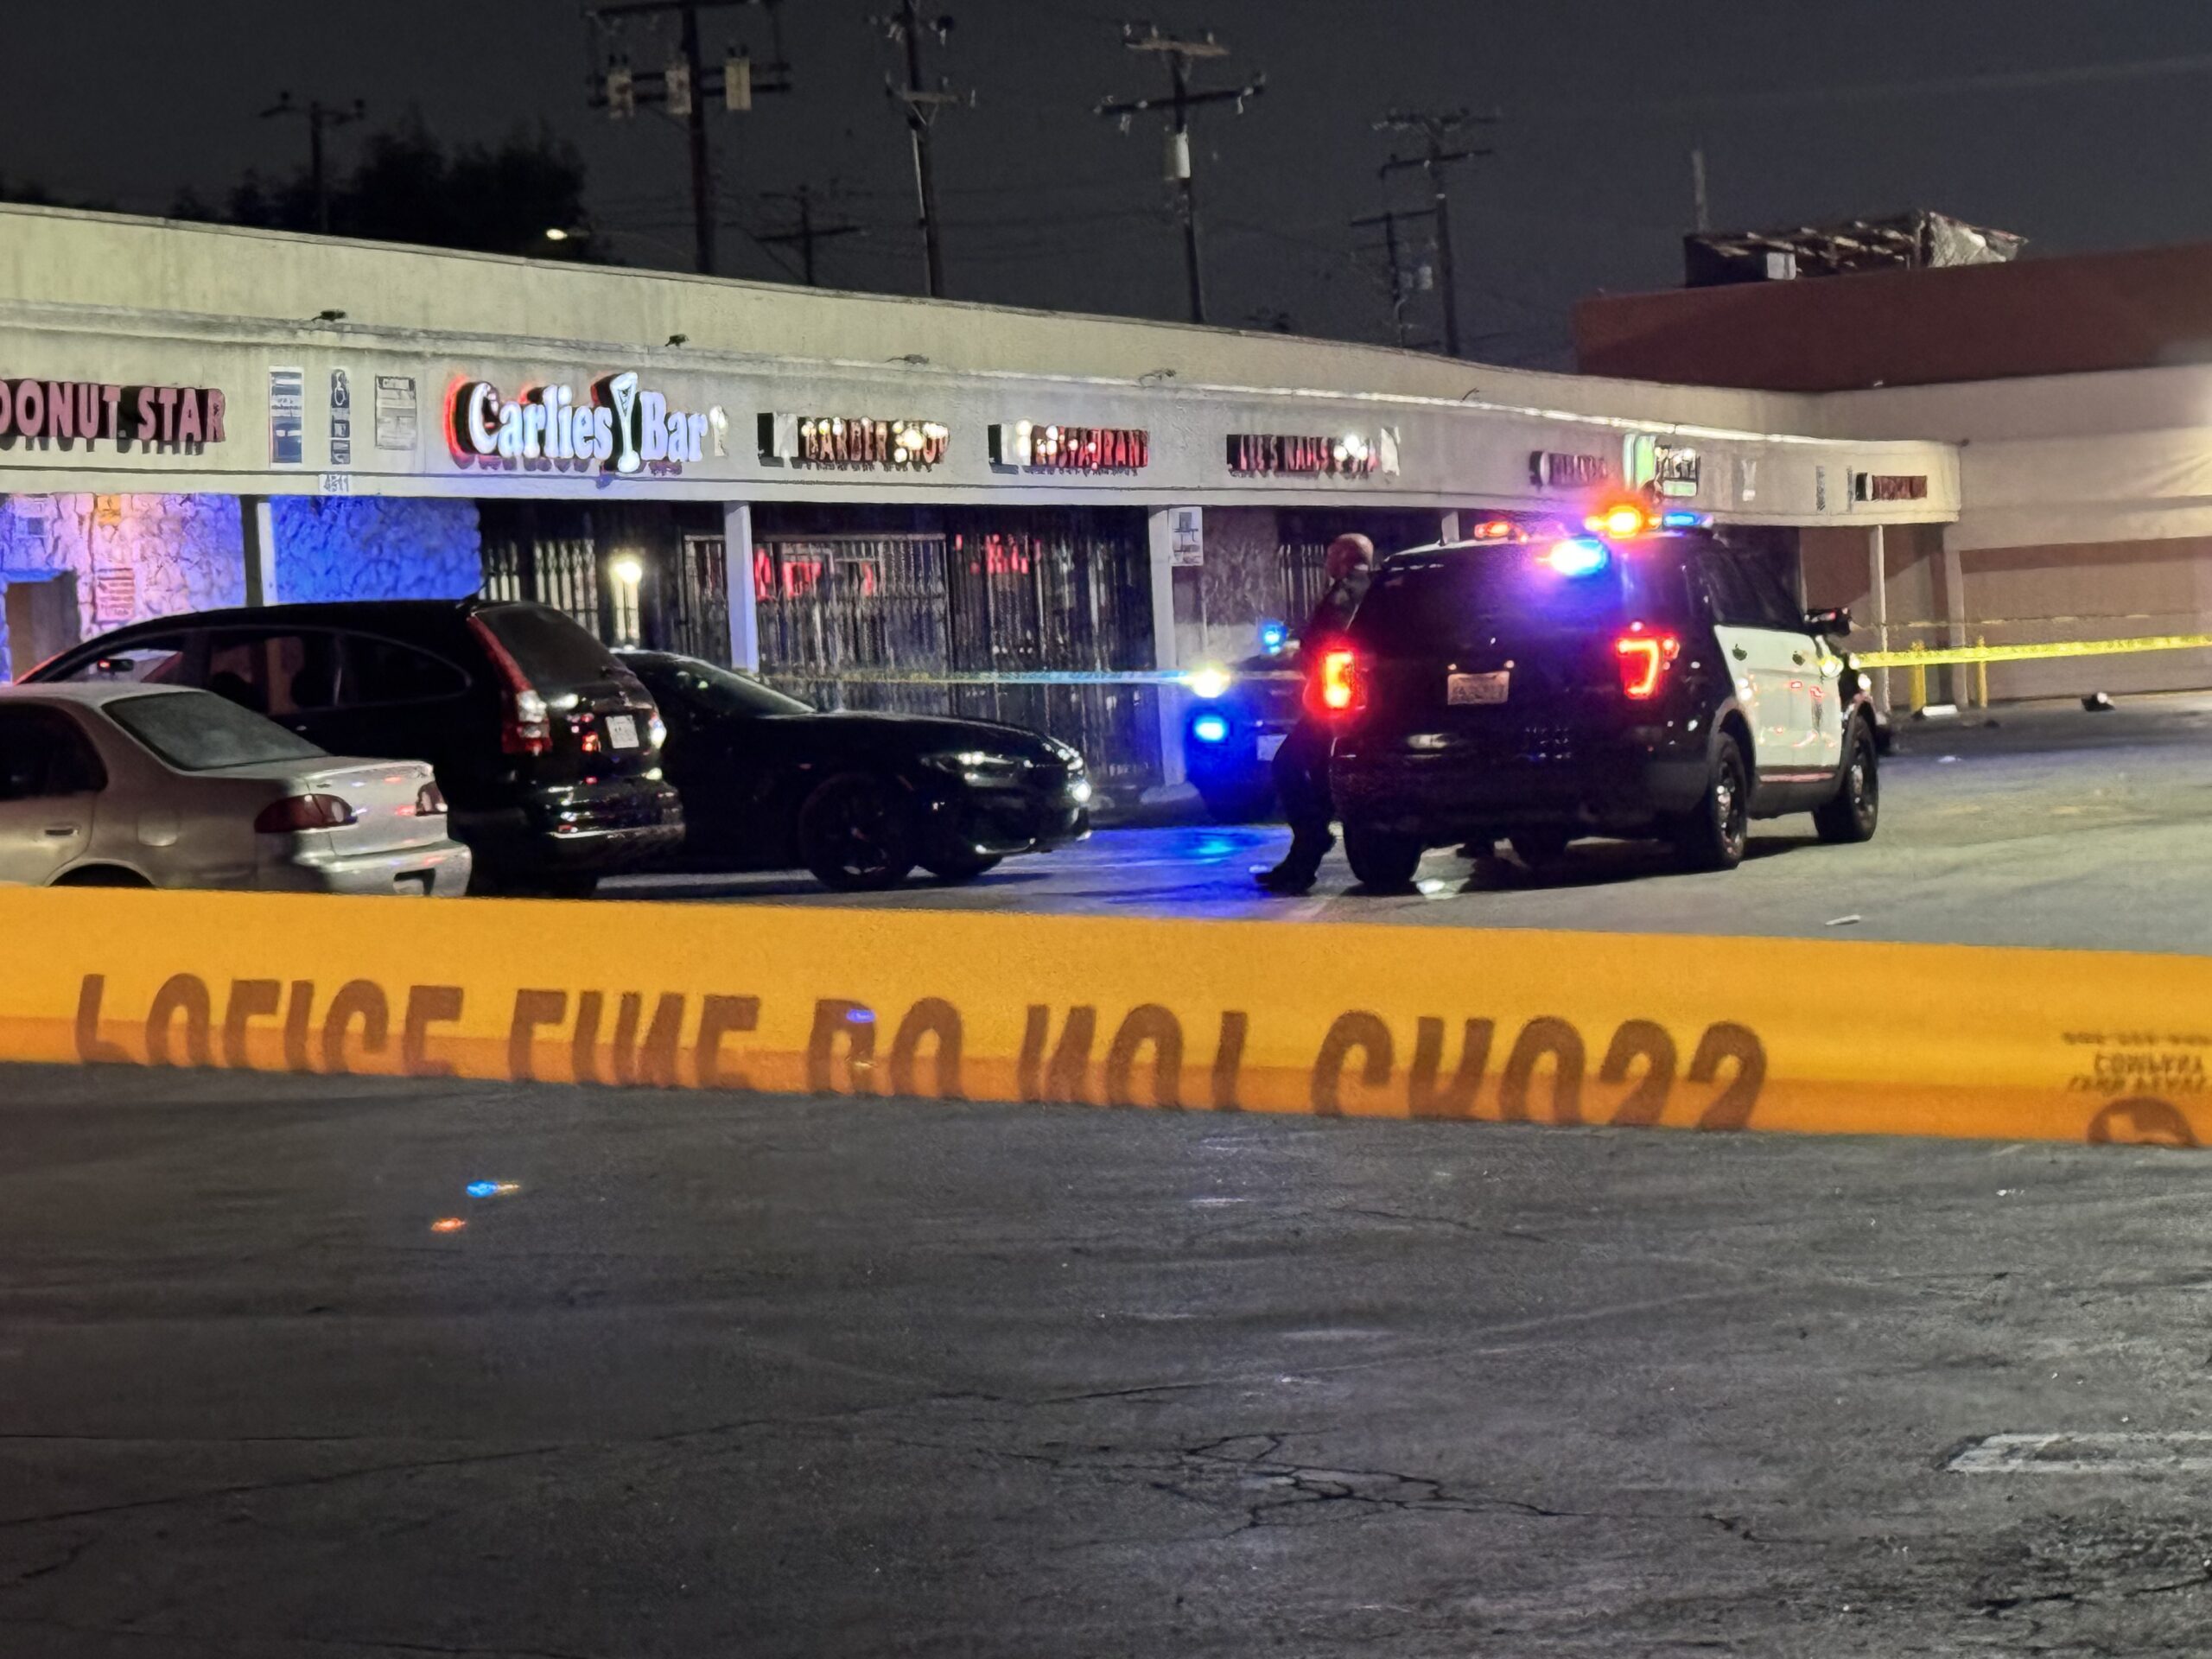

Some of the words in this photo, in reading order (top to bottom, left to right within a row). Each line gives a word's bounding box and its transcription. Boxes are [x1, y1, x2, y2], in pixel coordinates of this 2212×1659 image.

[137, 386, 226, 442] STAR
[465, 381, 613, 460] Carlies
[639, 391, 709, 462] Bar
